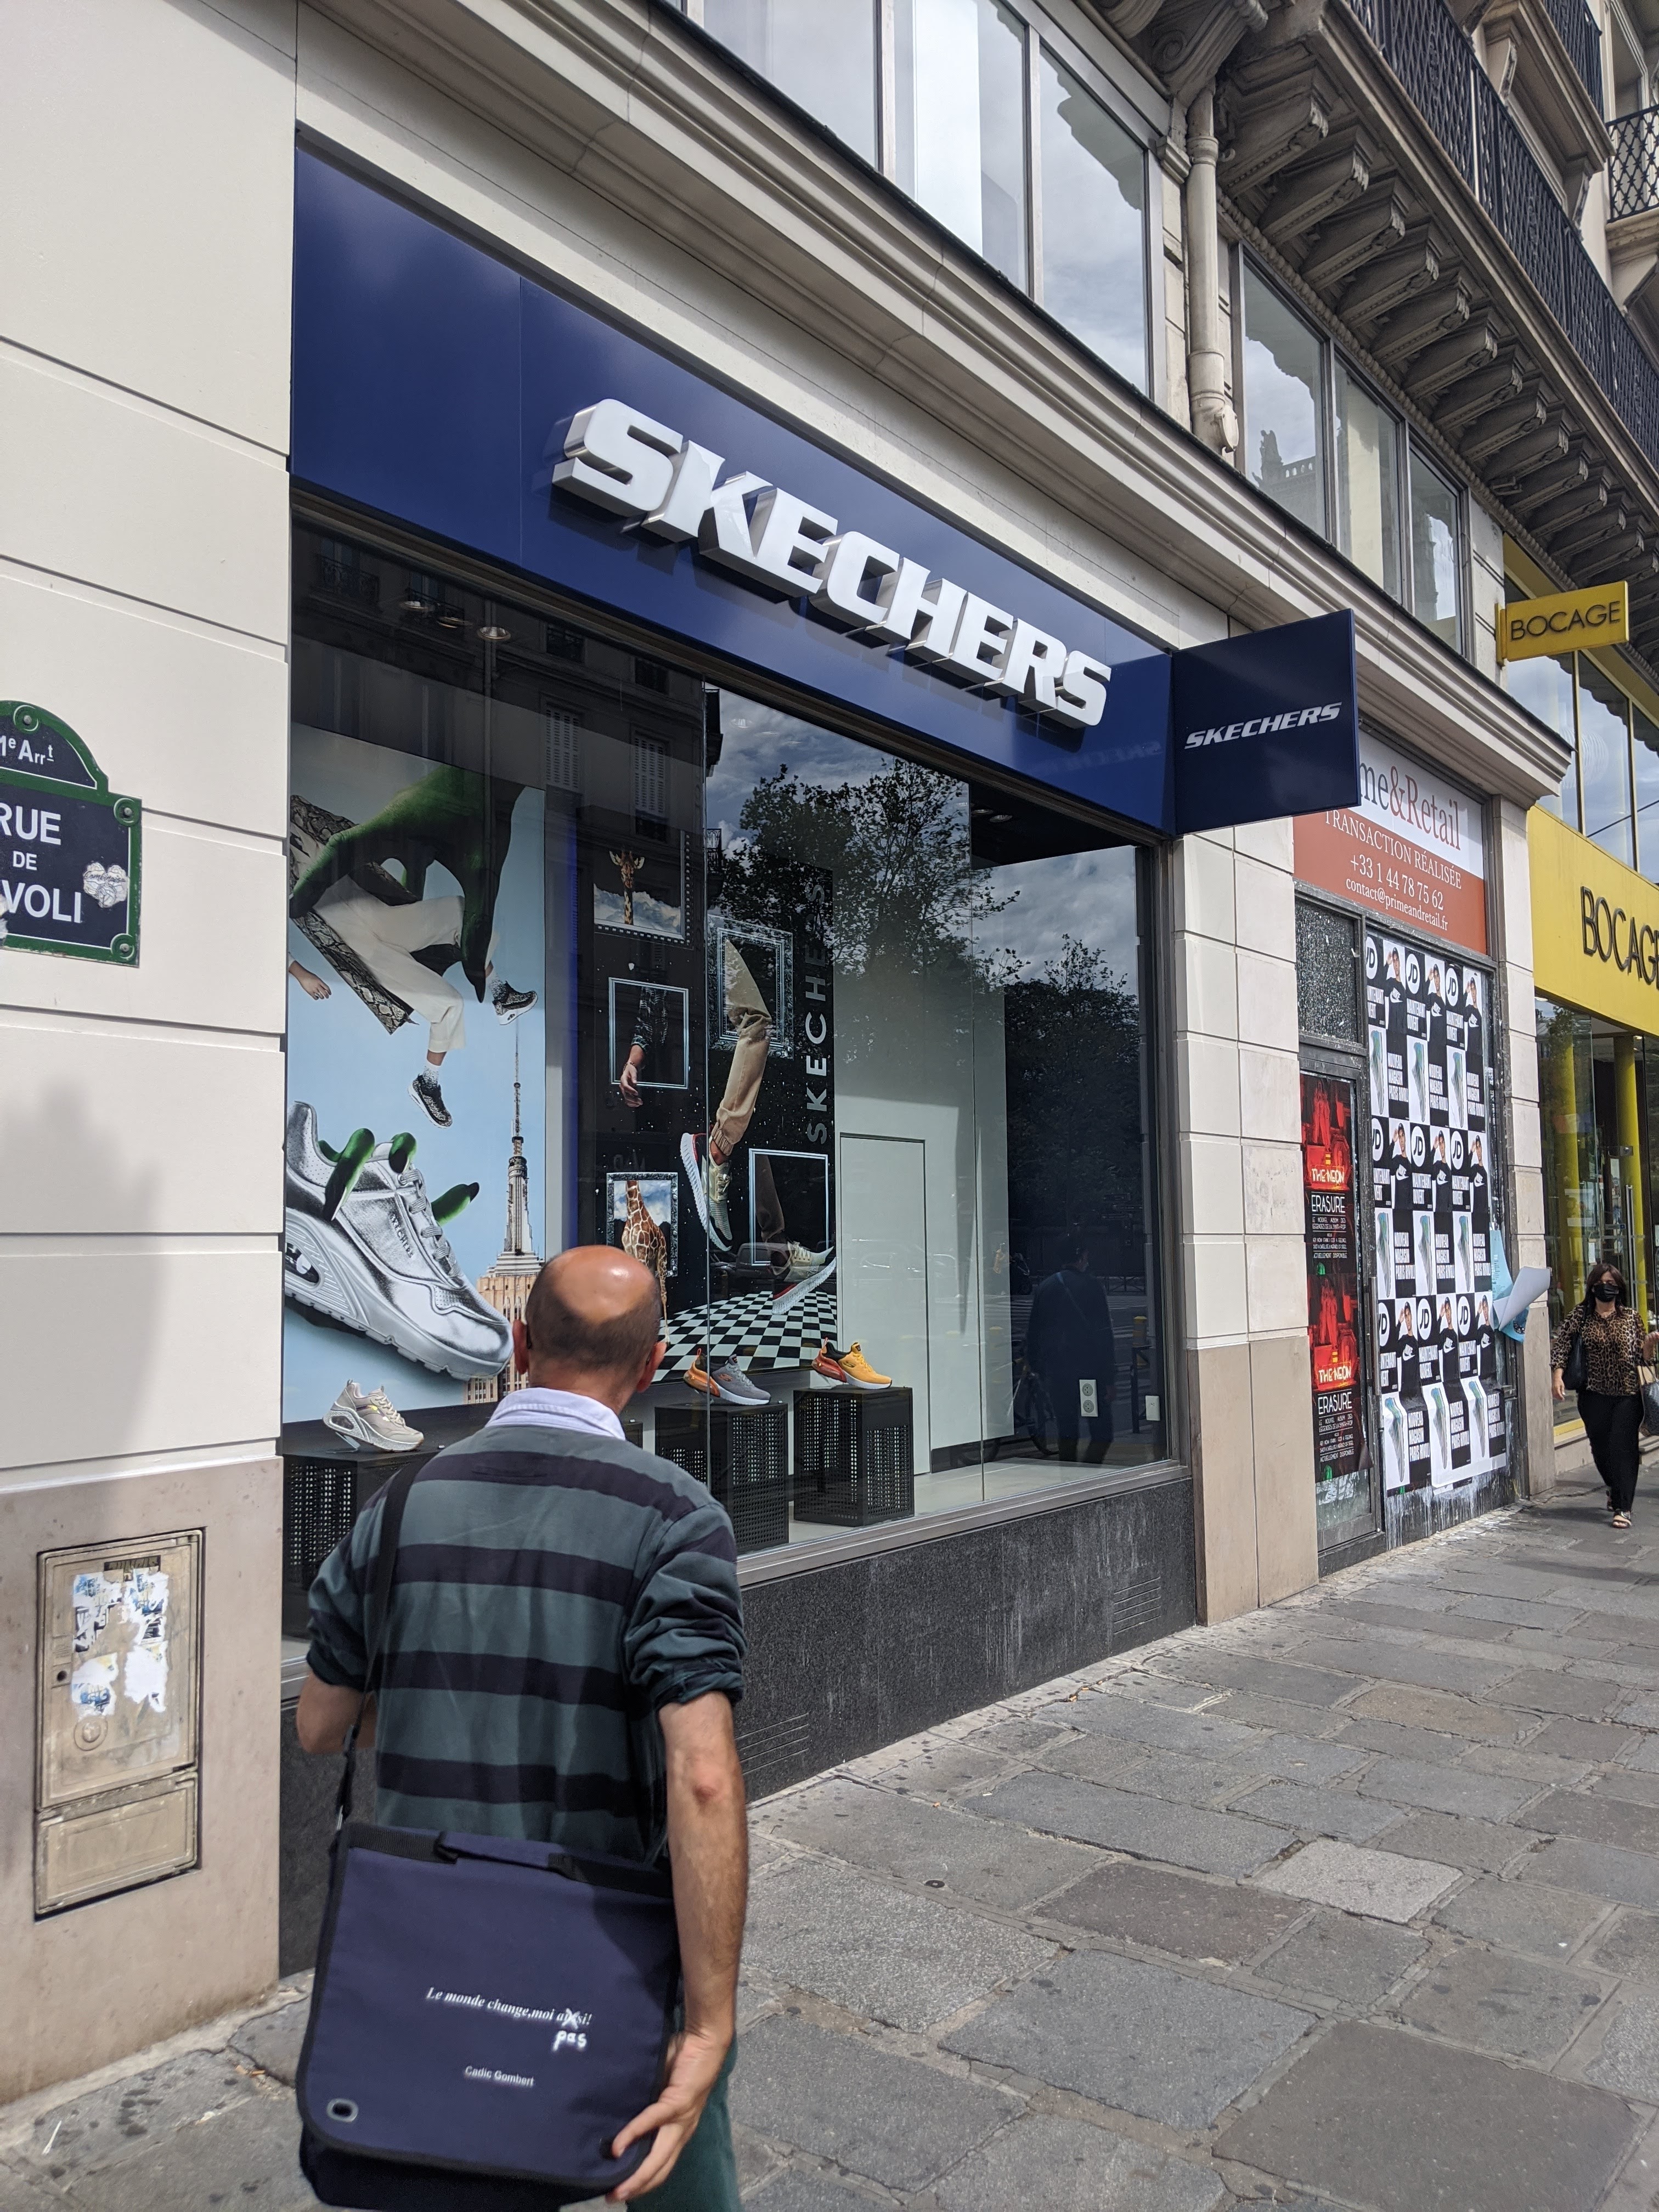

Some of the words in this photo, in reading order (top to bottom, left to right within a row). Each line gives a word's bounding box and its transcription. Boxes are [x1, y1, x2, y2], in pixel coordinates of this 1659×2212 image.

[552, 399, 1111, 729] SKECHERS
[1511, 601, 1620, 641] BOCAGE
[1184, 702, 1342, 749] SKECHERS
[0, 803, 61, 845] RUE
[1325, 810, 1411, 865] TRANSACTION
[1414, 850, 1462, 889] RÉALISÉE
[13, 850, 37, 871] DE
[1351, 854, 1373, 878] +33
[1377, 863, 1383, 883] 1
[1386, 868, 1400, 890] 44
[1402, 874, 1415, 897] 78
[1418, 882, 1429, 904] 75
[1432, 890, 1443, 911] 62
[1346, 878, 1448, 931] contact@primeandretail.fr
[1408, 963, 1418, 984] JD
[1448, 977, 1457, 996] JD
[1414, 1136, 1424, 1156] JD
[1453, 1141, 1462, 1159] JD
[1312, 1169, 1325, 1182] THE
[1327, 1170, 1345, 1184] NEON
[1311, 1195, 1345, 1213] ERASURE
[1420, 1308, 1430, 1329] JD
[1460, 1306, 1469, 1325] JD
[1318, 1369, 1333, 1383] THE
[1334, 1365, 1351, 1380] NEON
[1318, 1392, 1352, 1414] ERASURE
[426, 1987, 443, 2000] Le
[444, 1994, 486, 2007] monde
[552, 2030, 587, 2052] pas
